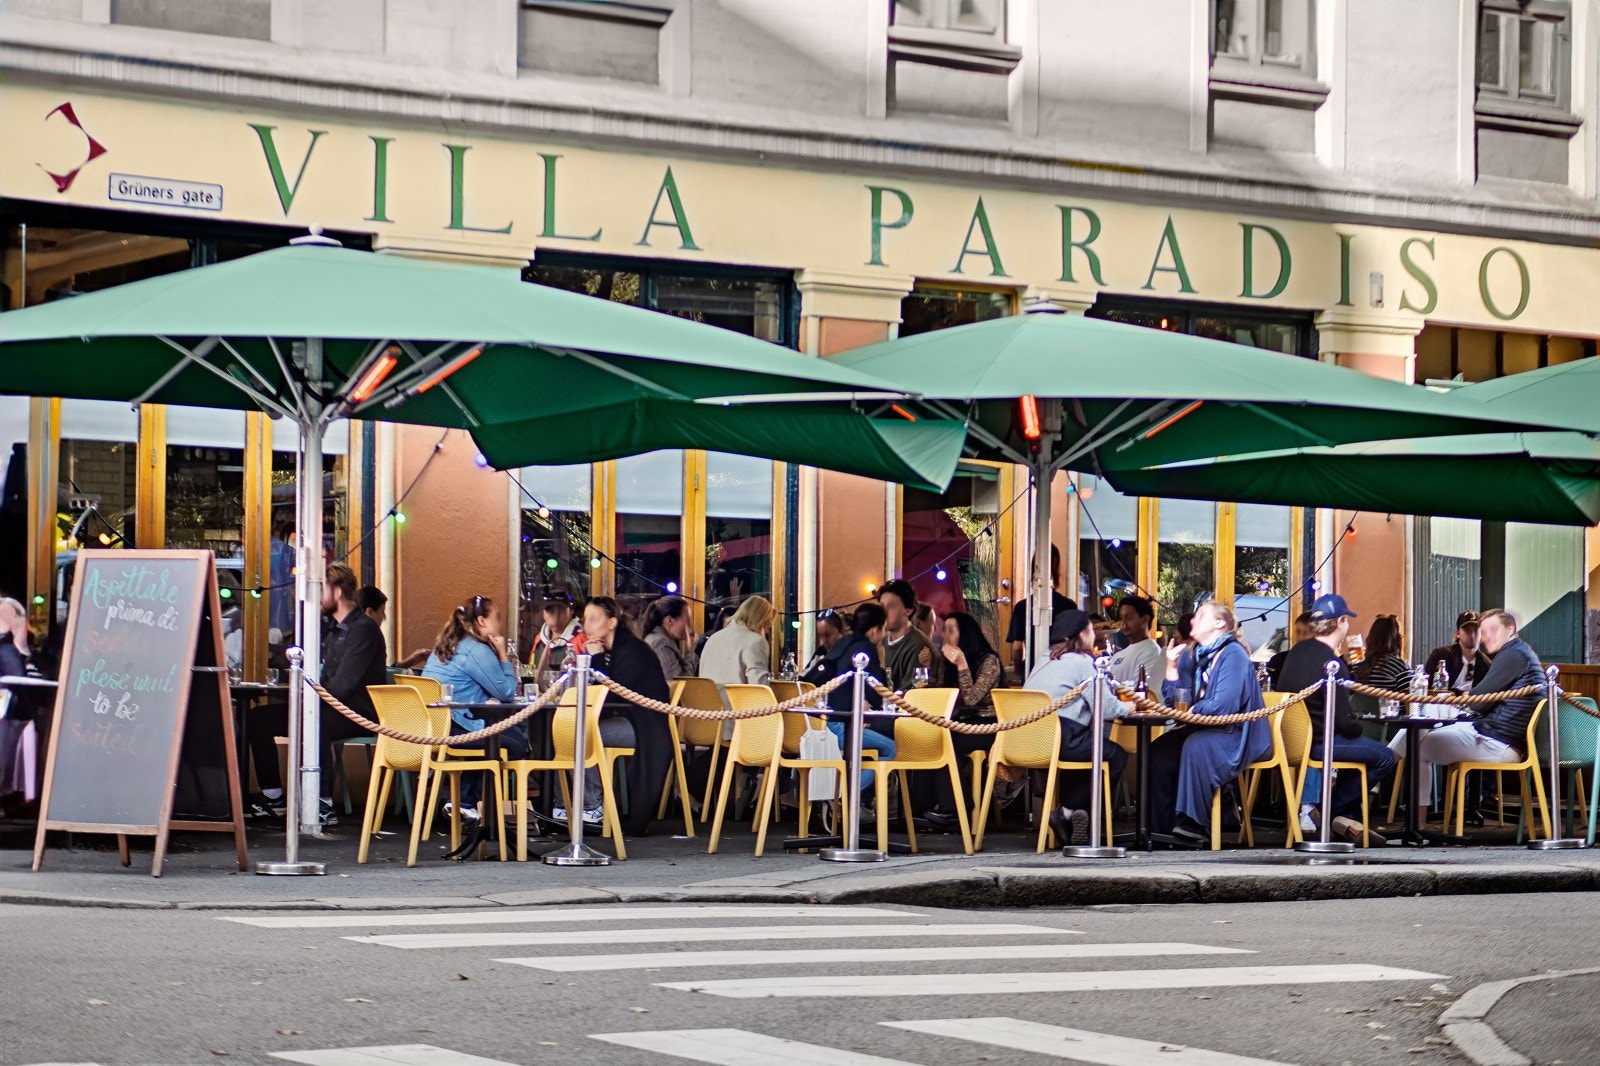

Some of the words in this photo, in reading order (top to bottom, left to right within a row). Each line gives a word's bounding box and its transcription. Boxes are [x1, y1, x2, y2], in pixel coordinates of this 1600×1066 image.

[118, 179, 174, 200] Grüners
[182, 189, 214, 205] gate
[247, 122, 704, 252] VILLA
[864, 184, 1531, 322] PARADISO
[103, 598, 156, 631] prima
[88, 690, 112, 716] to
[114, 691, 140, 721] be
